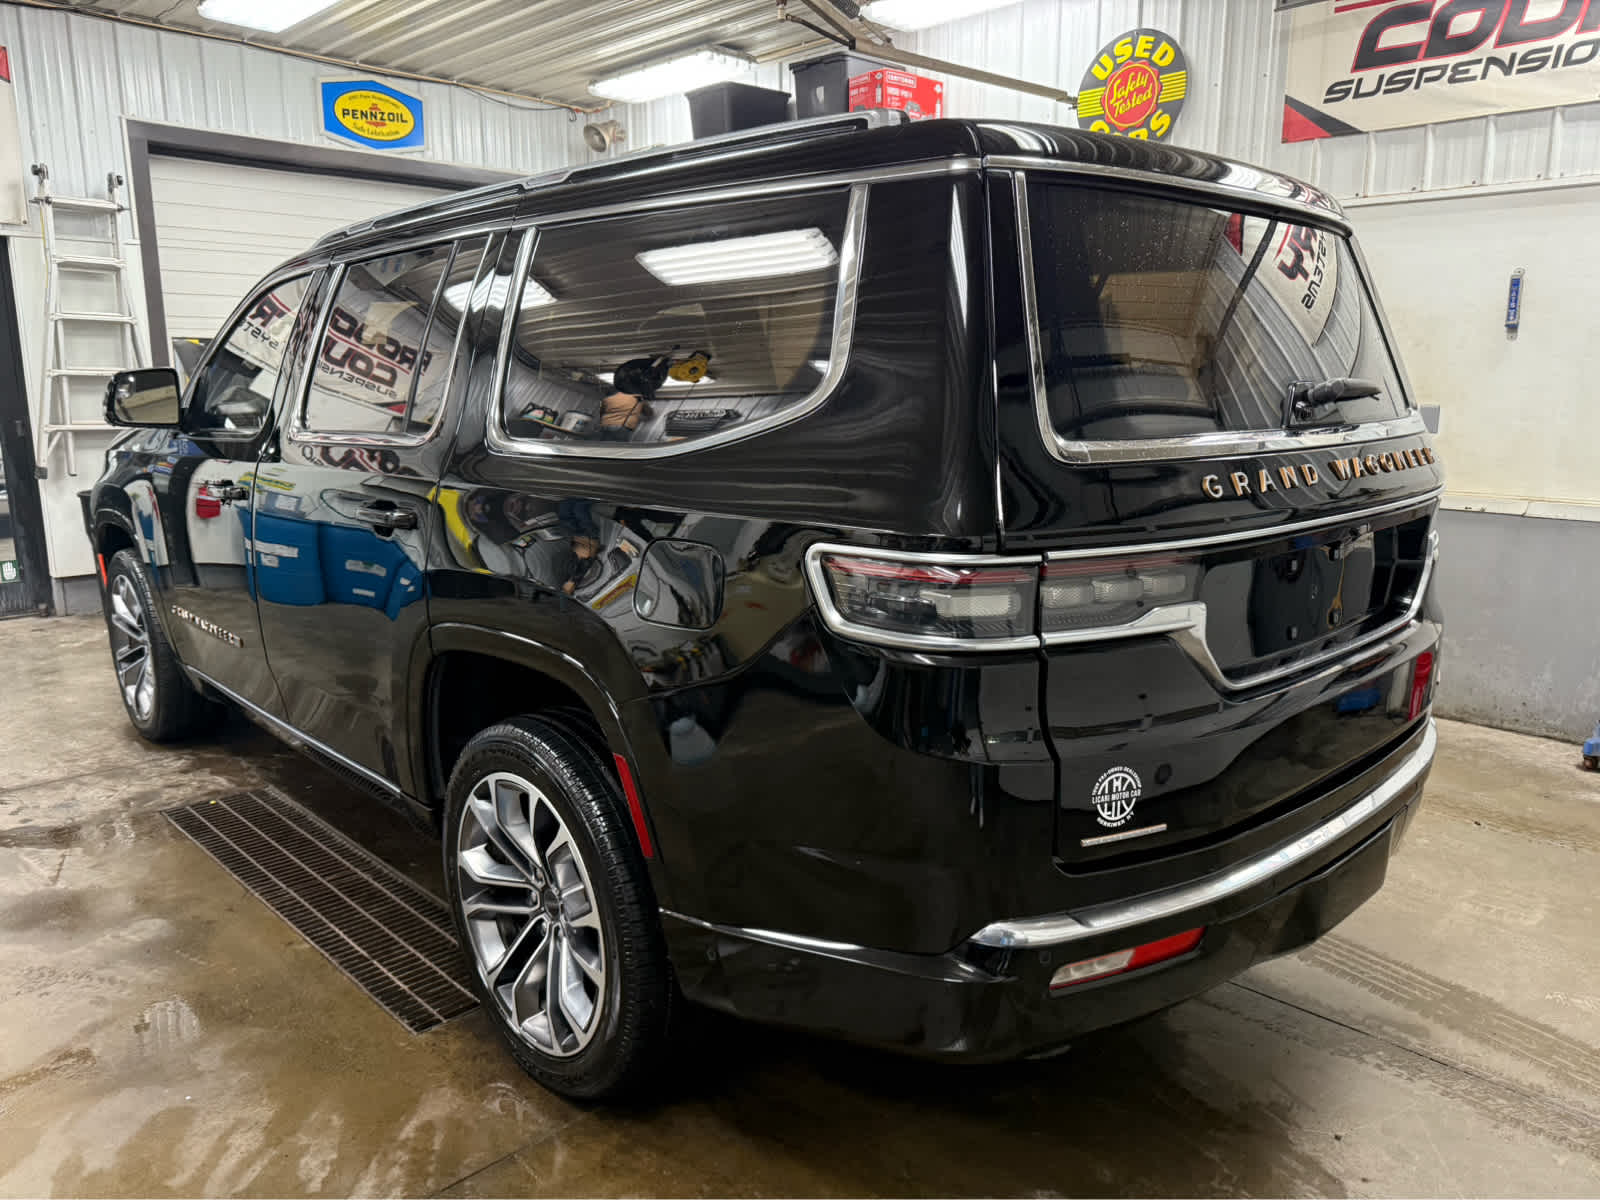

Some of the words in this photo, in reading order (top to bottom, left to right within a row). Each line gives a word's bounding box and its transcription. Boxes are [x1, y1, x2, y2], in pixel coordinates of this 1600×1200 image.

[1091, 35, 1176, 80] USED
[1110, 72, 1149, 104] Safety
[1113, 83, 1152, 118] Tested
[342, 108, 408, 123] PENNZOIL
[1202, 463, 1319, 499] GRAND
[1111, 792, 1129, 801] MOTOR
[1131, 789, 1141, 798] CAR
